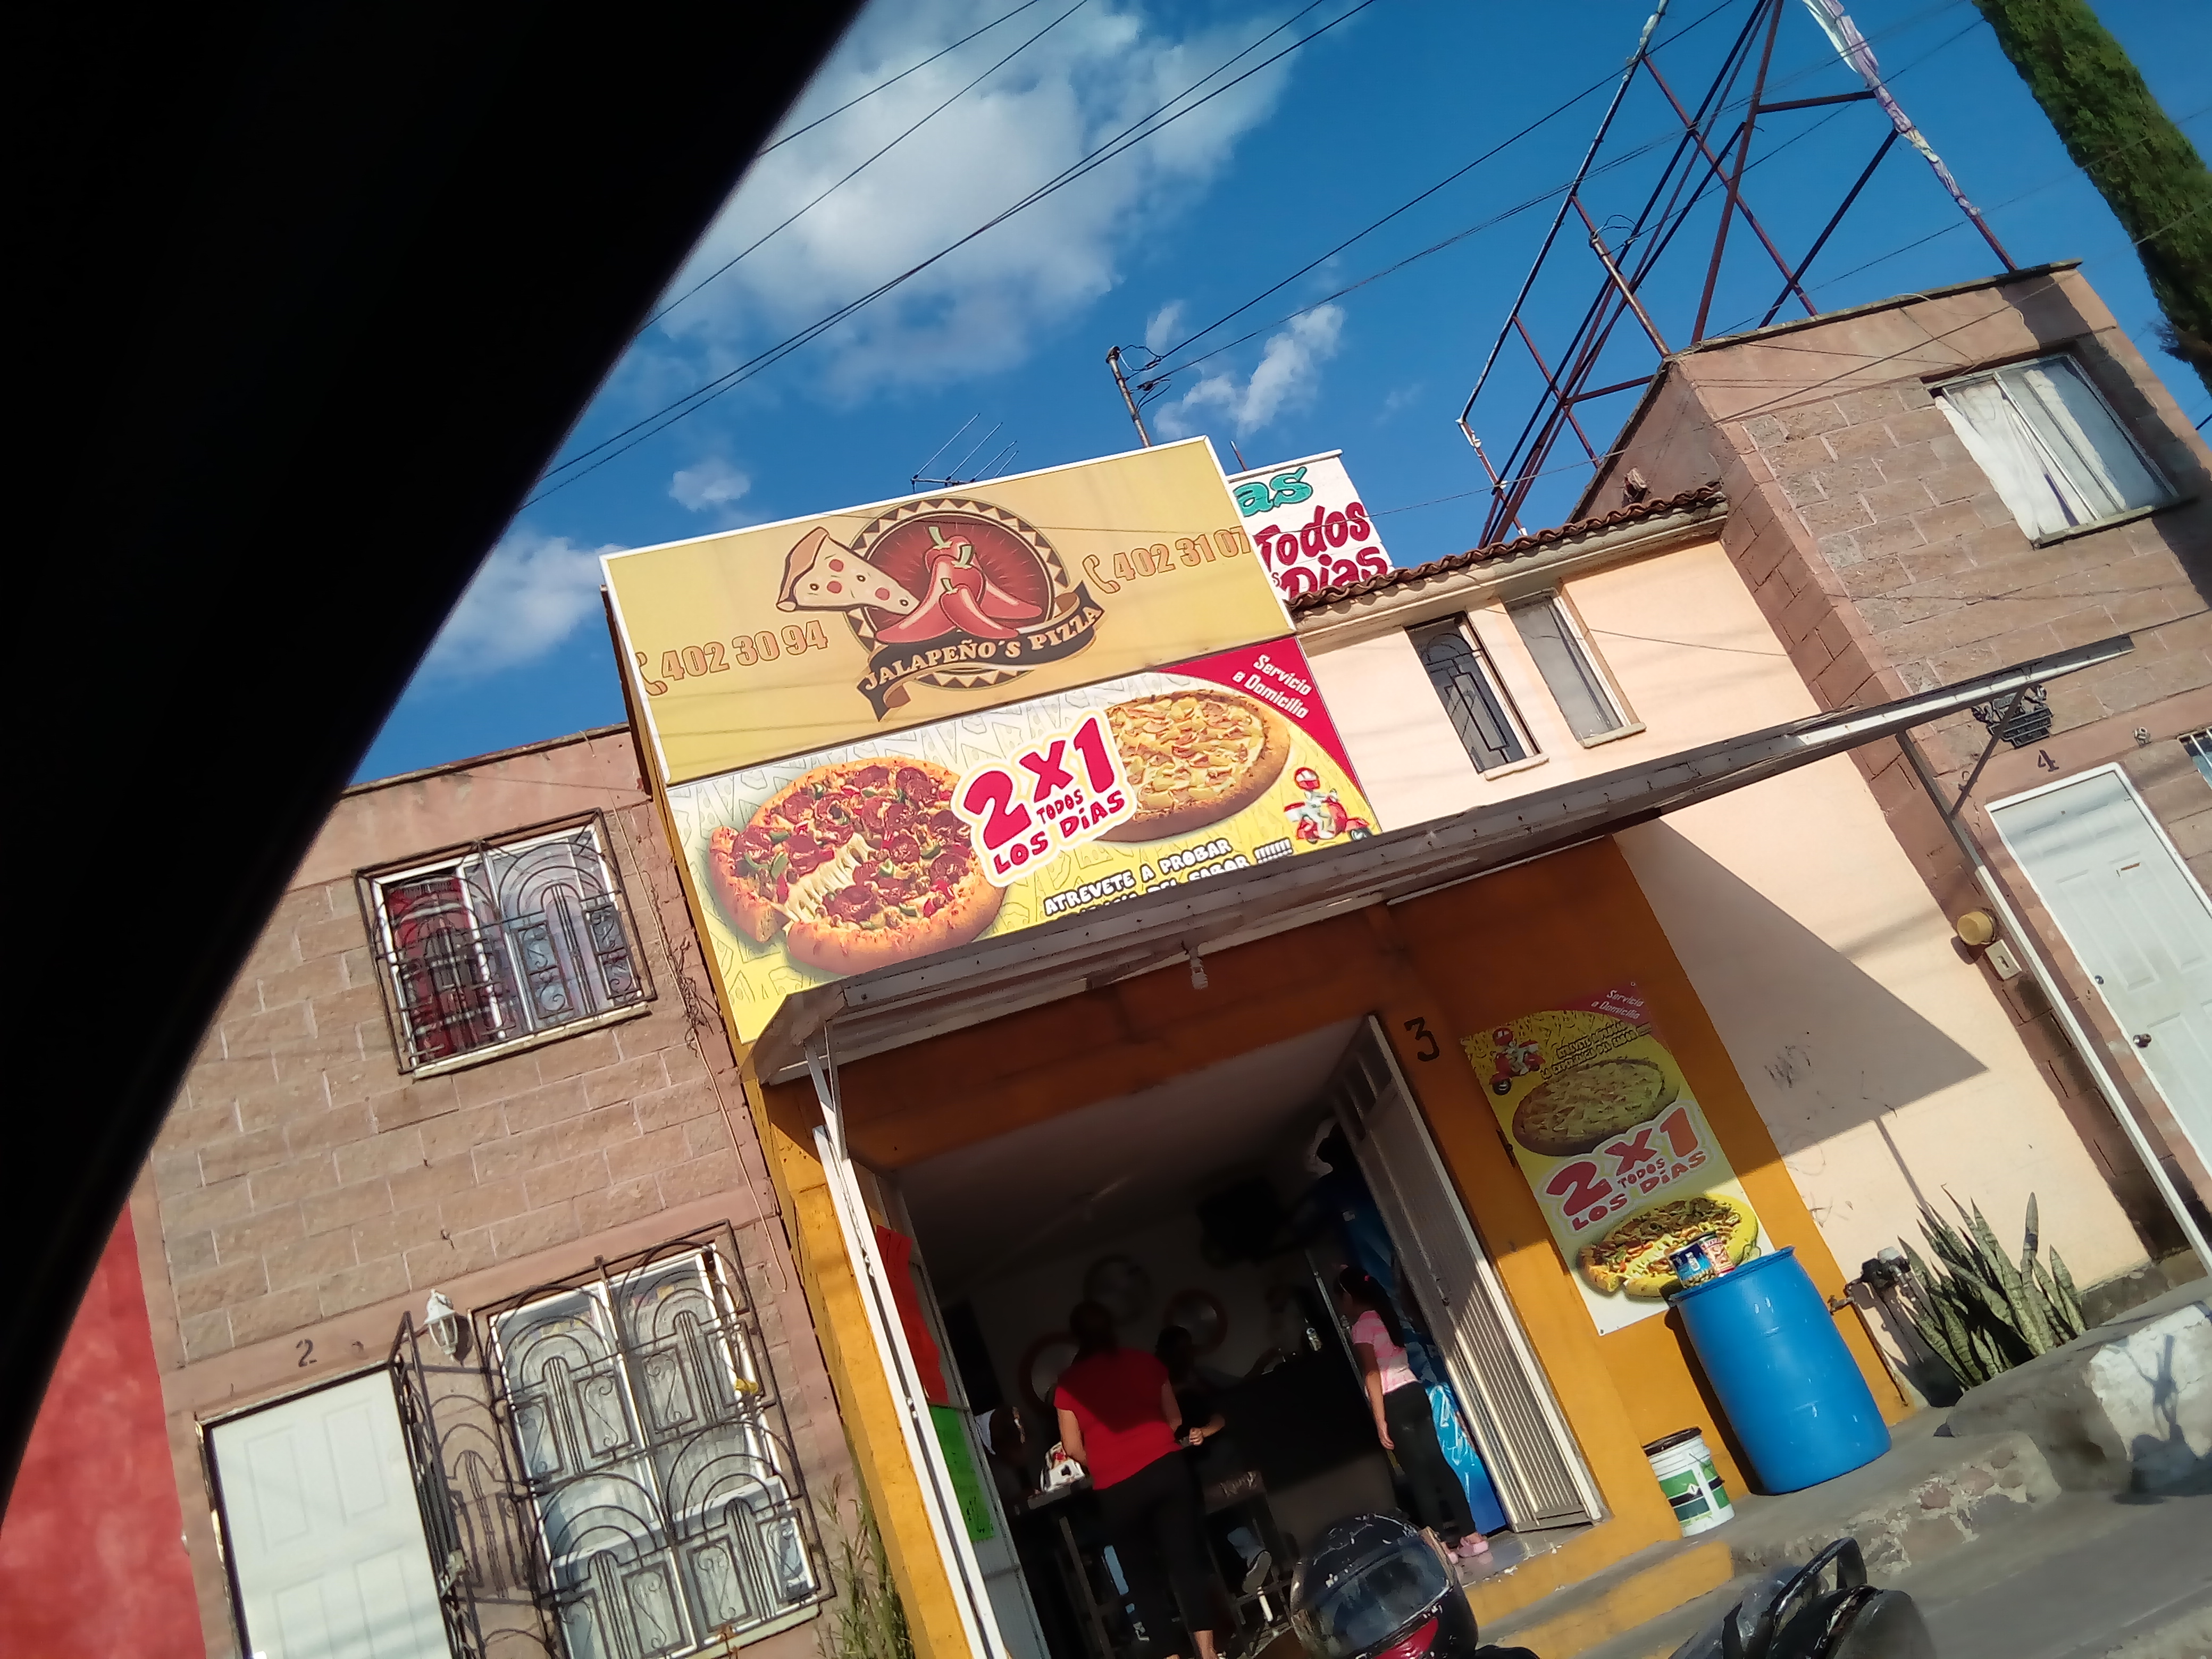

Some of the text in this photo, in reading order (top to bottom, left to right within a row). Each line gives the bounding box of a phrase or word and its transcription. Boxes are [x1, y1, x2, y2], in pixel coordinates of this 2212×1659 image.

[1113, 525, 1251, 581] 402 31 07
[1252, 501, 1371, 573] Todos
[661, 619, 828, 681] 402 30 94
[1028, 606, 1102, 651] PIZZA
[1231, 670, 1310, 719] a Domicilio
[1253, 654, 1312, 696] Servicio
[2037, 749, 2060, 772] 4
[1036, 788, 1084, 825] TODOS
[993, 831, 1049, 875] LOS
[1043, 870, 1137, 917] ATREVETE
[1139, 863, 1156, 883] A
[1158, 837, 1234, 875] PROBAR
[1606, 990, 1645, 1008] Servicio
[1403, 1016, 1440, 1062] 3
[1617, 1158, 1666, 1189] TODOS
[1571, 1193, 1628, 1231] LOS
[296, 1338, 318, 1368] 2
